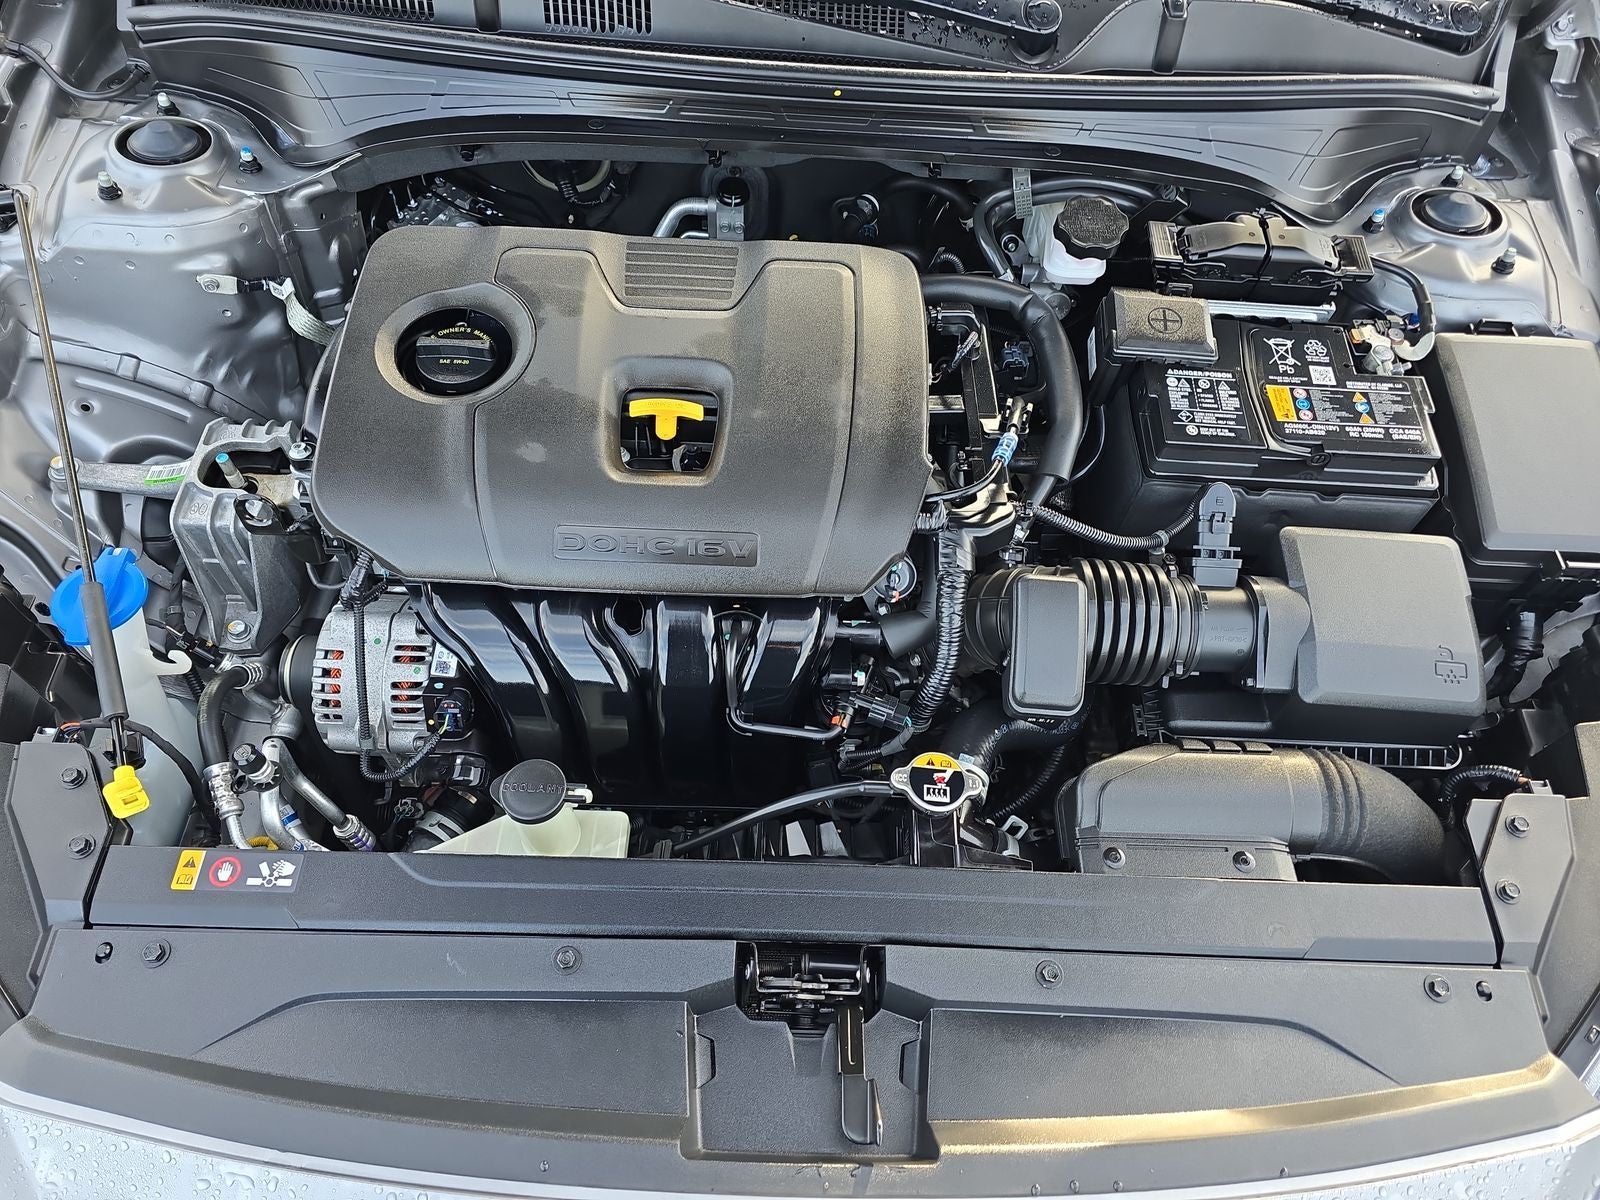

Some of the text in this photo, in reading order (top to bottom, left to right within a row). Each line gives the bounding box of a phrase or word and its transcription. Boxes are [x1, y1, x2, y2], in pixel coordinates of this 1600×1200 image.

[437, 327, 472, 336] OWNER'S
[1174, 369, 1233, 378] DANGER/POISON
[1278, 364, 1295, 374] Pb
[557, 532, 756, 560] DOHC 16V
[502, 782, 565, 795] COOLANT
